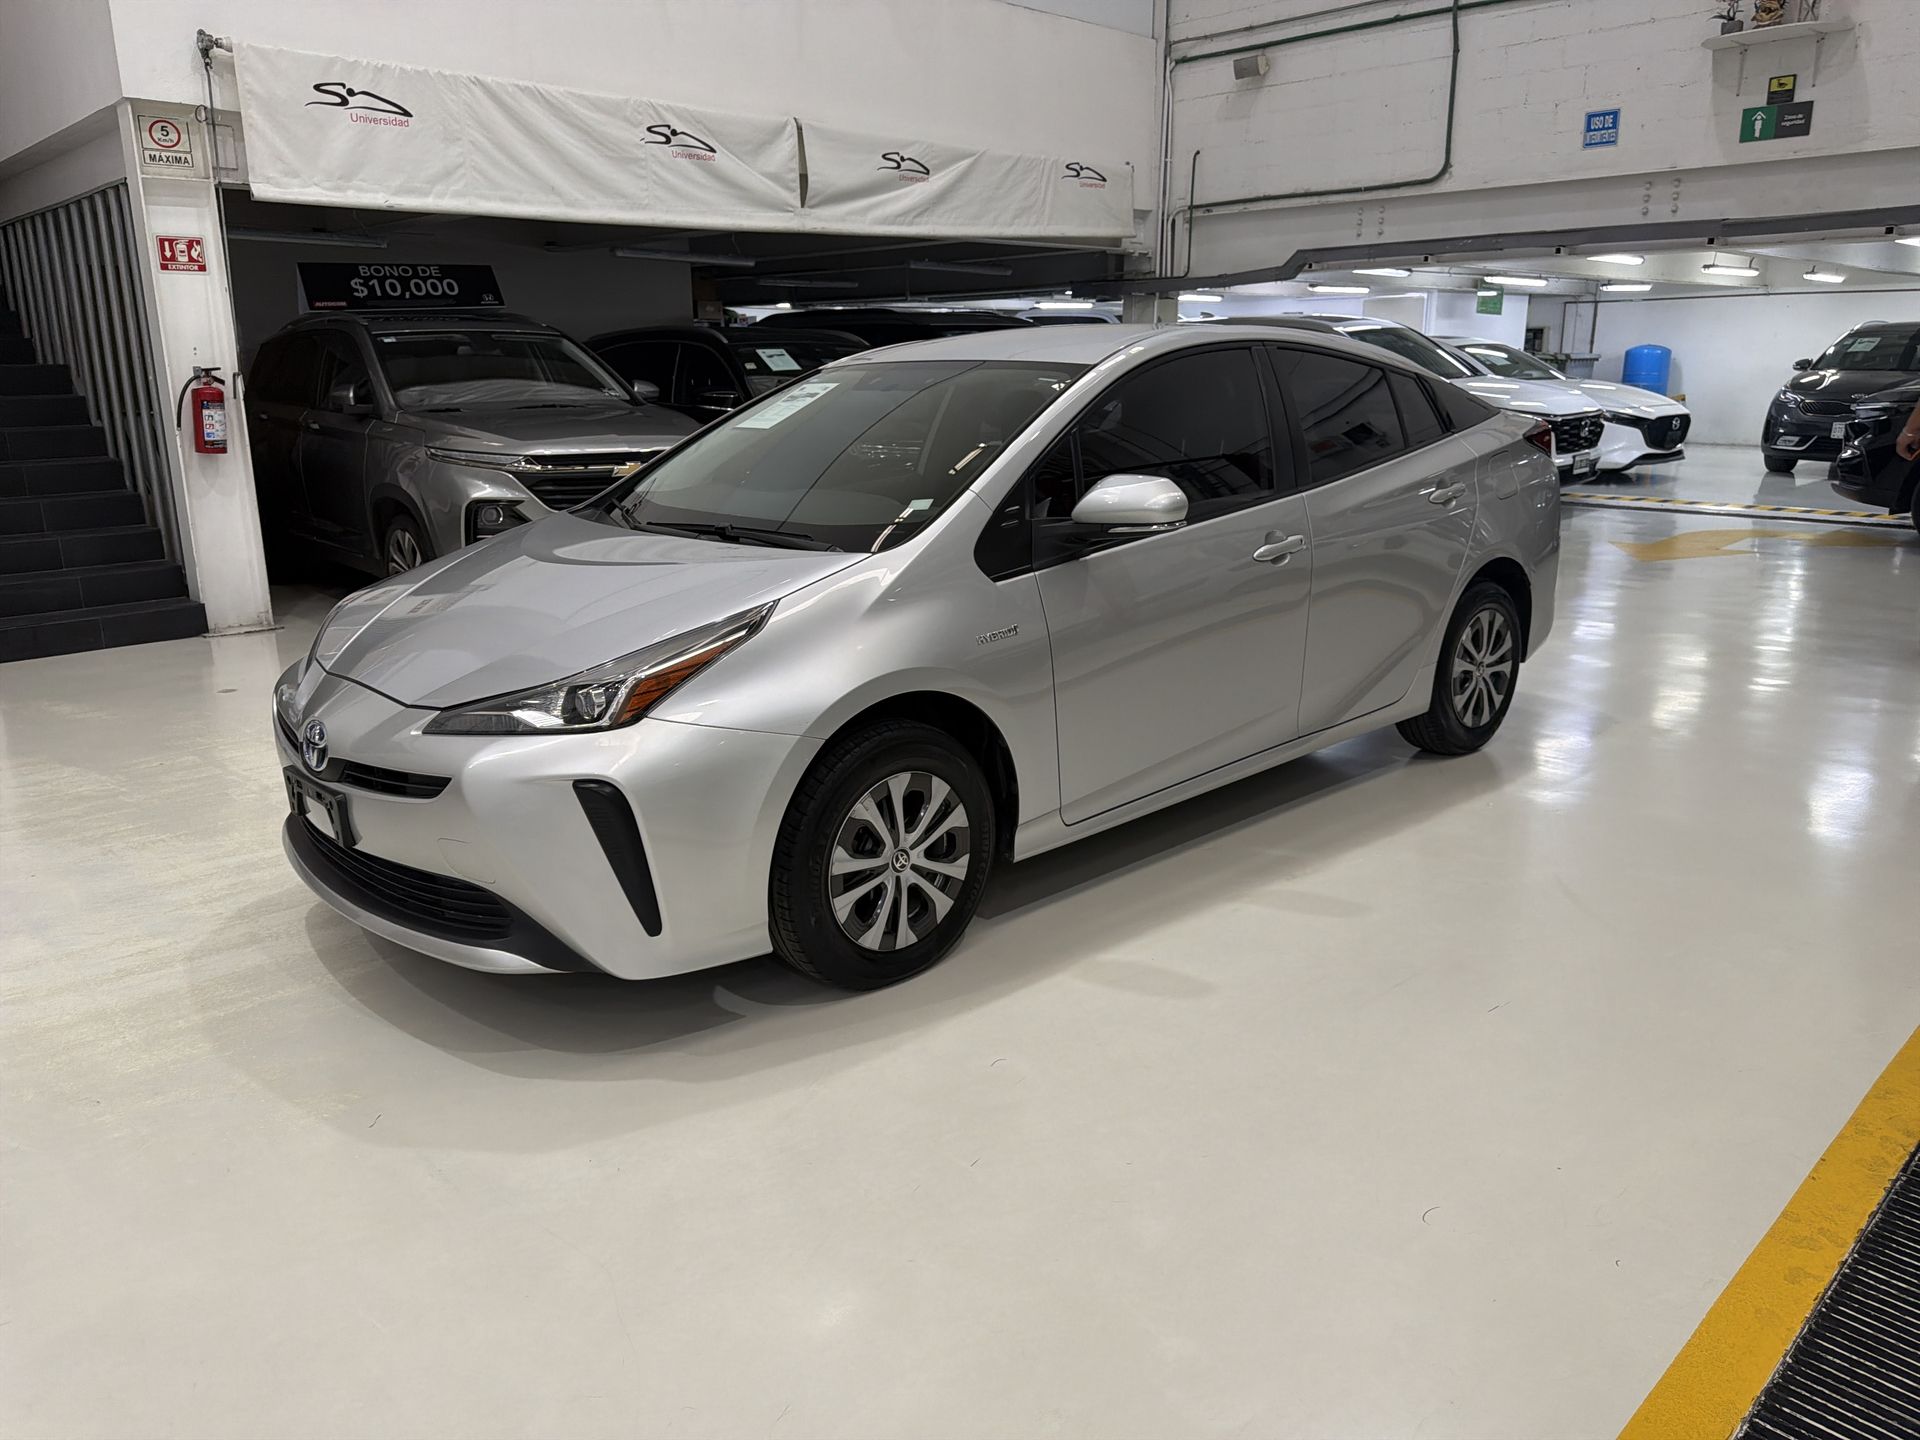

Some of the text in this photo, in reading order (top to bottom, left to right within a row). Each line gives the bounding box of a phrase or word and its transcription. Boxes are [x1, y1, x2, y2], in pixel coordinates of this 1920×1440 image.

[350, 112, 410, 128] Universidad
[1590, 115, 1614, 129] USO DE
[160, 125, 170, 138] 5
[148, 152, 191, 166] MÁXIMA
[671, 149, 716, 162] Universidad
[167, 263, 199, 271] EXTINTOR
[357, 264, 443, 278] BONO DE
[350, 277, 460, 299] $10,000
